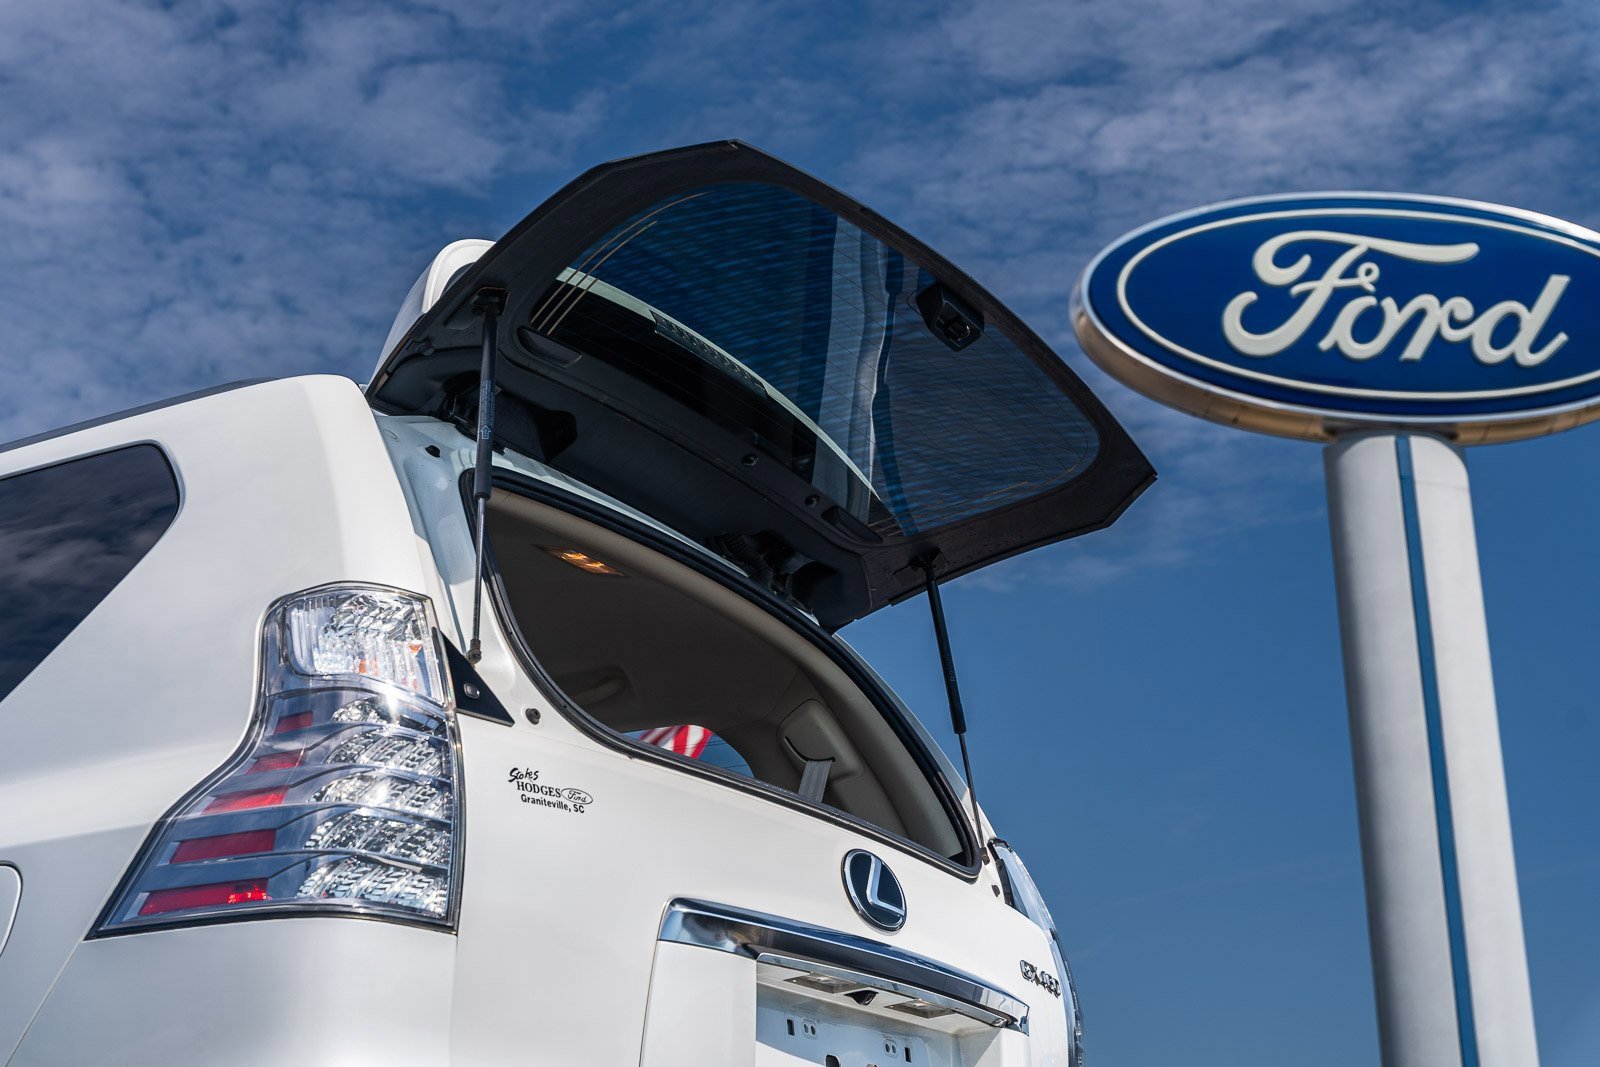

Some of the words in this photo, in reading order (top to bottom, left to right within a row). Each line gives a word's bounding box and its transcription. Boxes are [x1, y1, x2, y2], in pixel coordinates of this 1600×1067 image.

[1222, 230, 1571, 367] Ford
[508, 767, 539, 783] Stokes
[516, 780, 561, 798] HODGES
[520, 793, 572, 812] Graniteville,
[573, 803, 585, 814] SC
